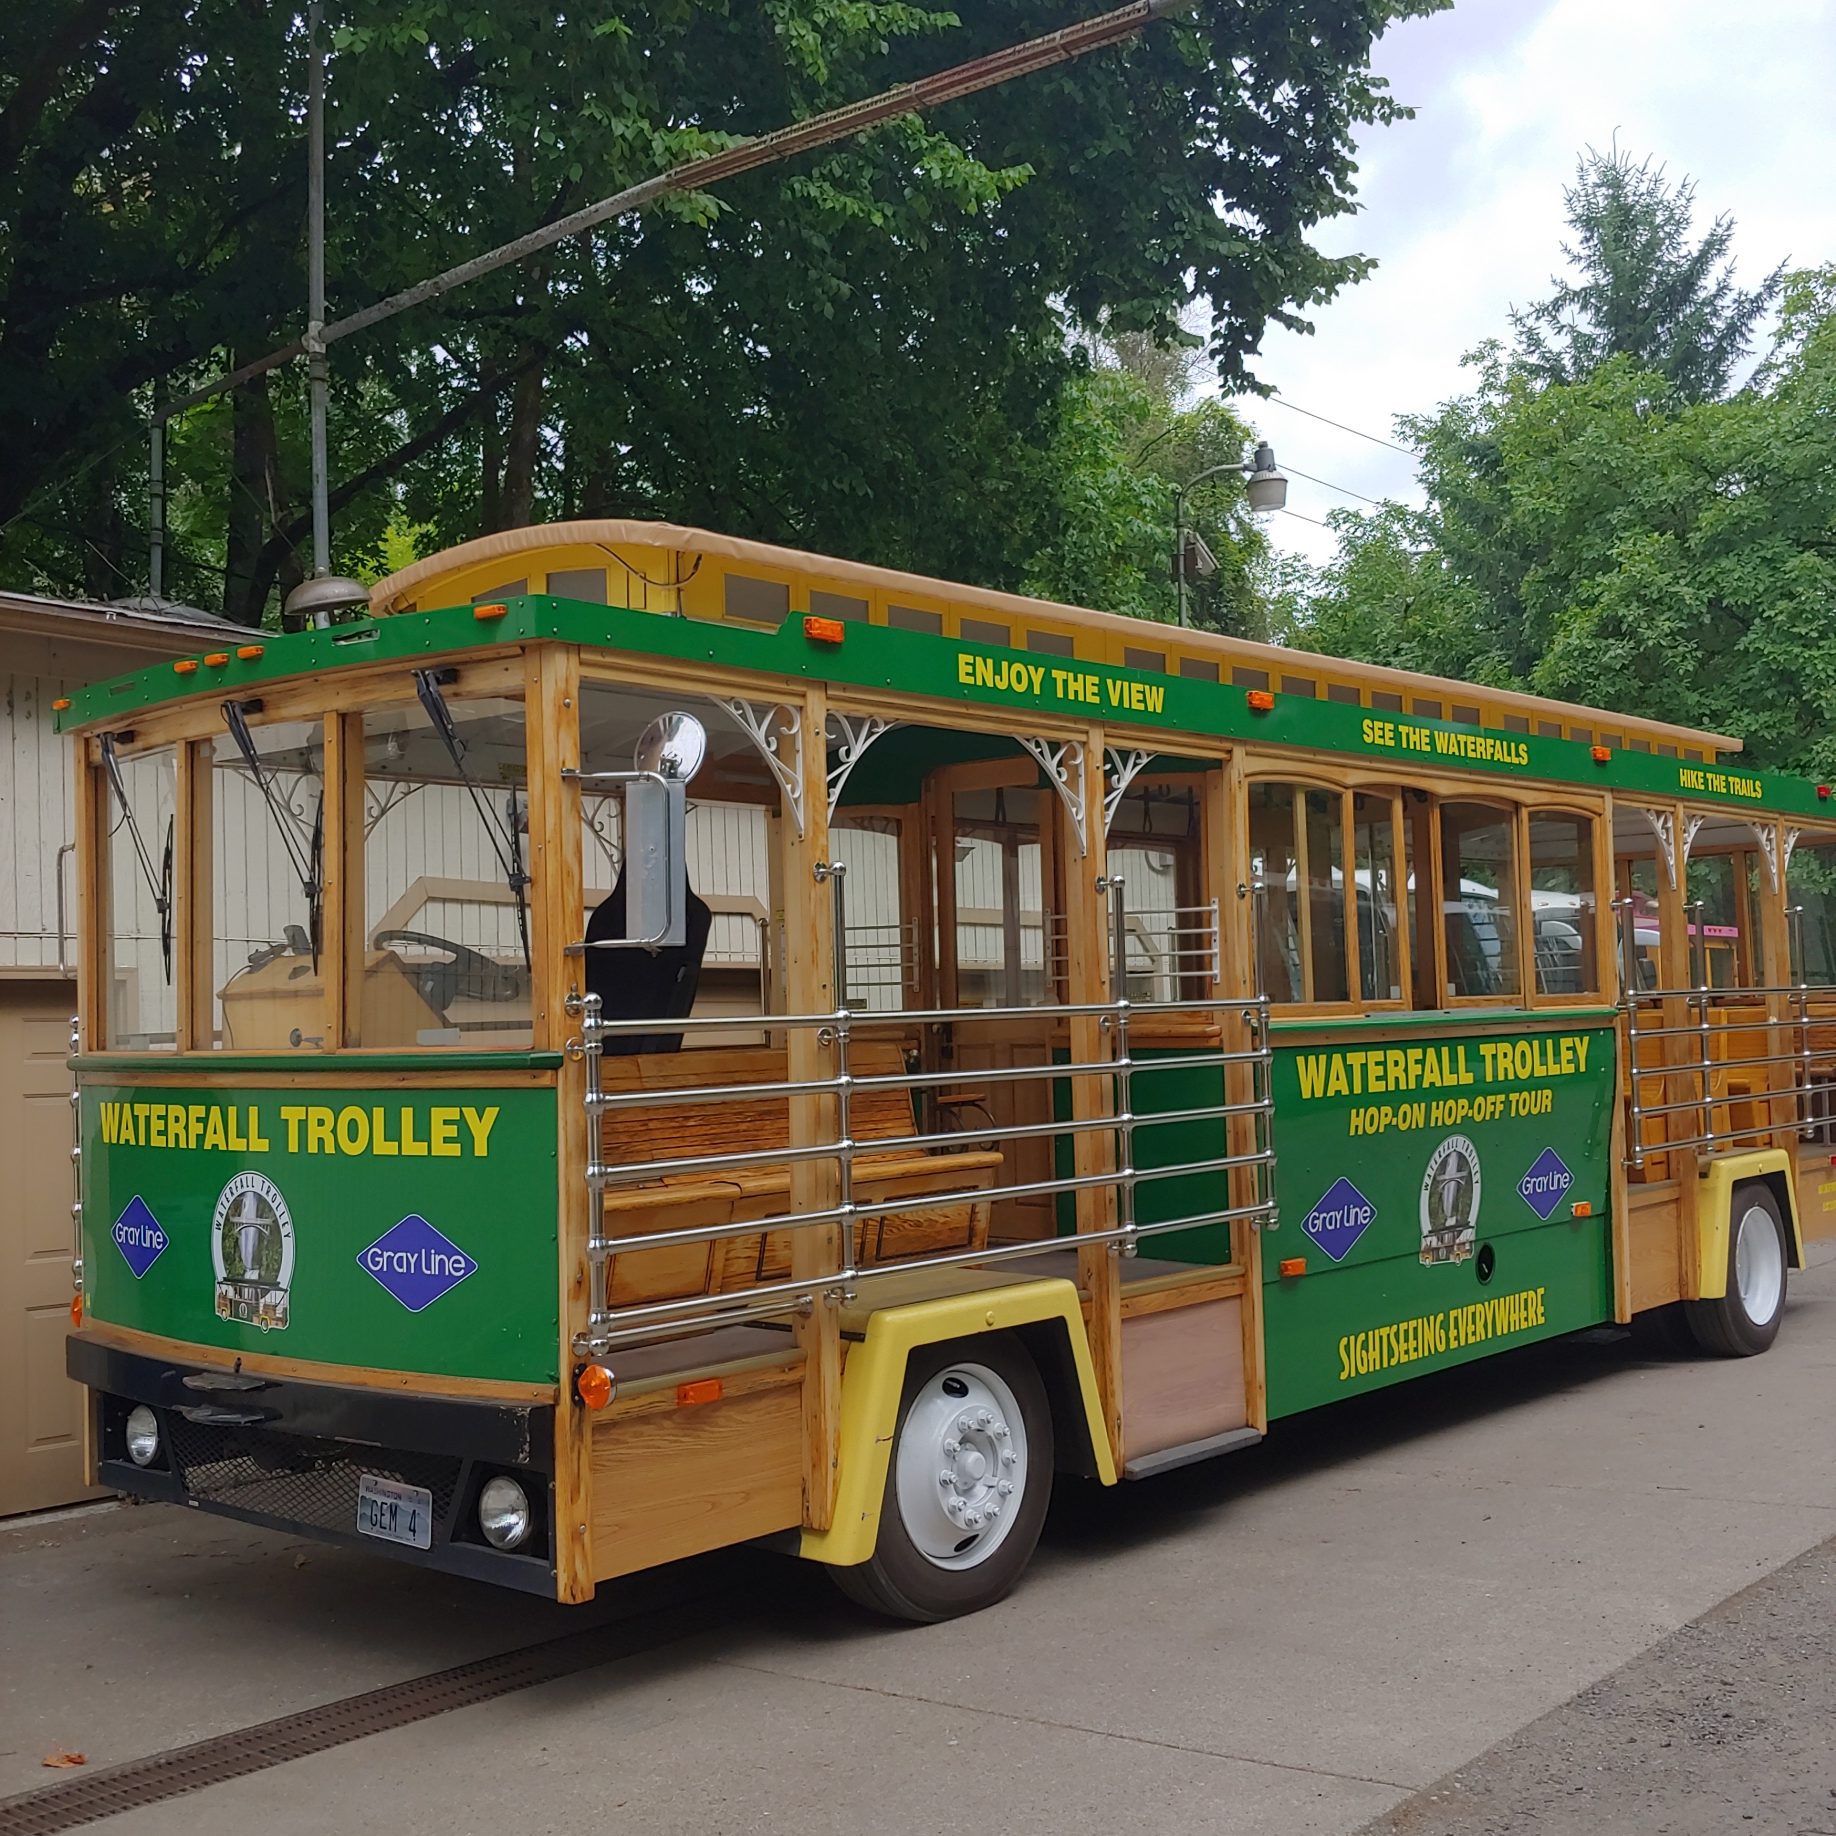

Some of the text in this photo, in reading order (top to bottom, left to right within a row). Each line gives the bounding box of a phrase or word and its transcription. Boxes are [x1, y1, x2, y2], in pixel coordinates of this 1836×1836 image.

[957, 653, 1165, 713] ENJOY THE VIEW
[1362, 718, 1529, 765] SEE THE WATERFALLS
[1679, 767, 1762, 799] HIKE THE TRAILS
[1296, 1036, 1590, 1099] WATERFALL TROLLEY
[100, 1101, 500, 1157] WATERFALL TROLLEY
[1349, 1089, 1553, 1136] HOP-ON HOP-OFF TOUR
[215, 1174, 292, 1239] WATERFALL TROLLEY
[1338, 1287, 1546, 1380] SIGHTSEEING EVERYWHERE
[370, 1499, 417, 1538] GEM 4
